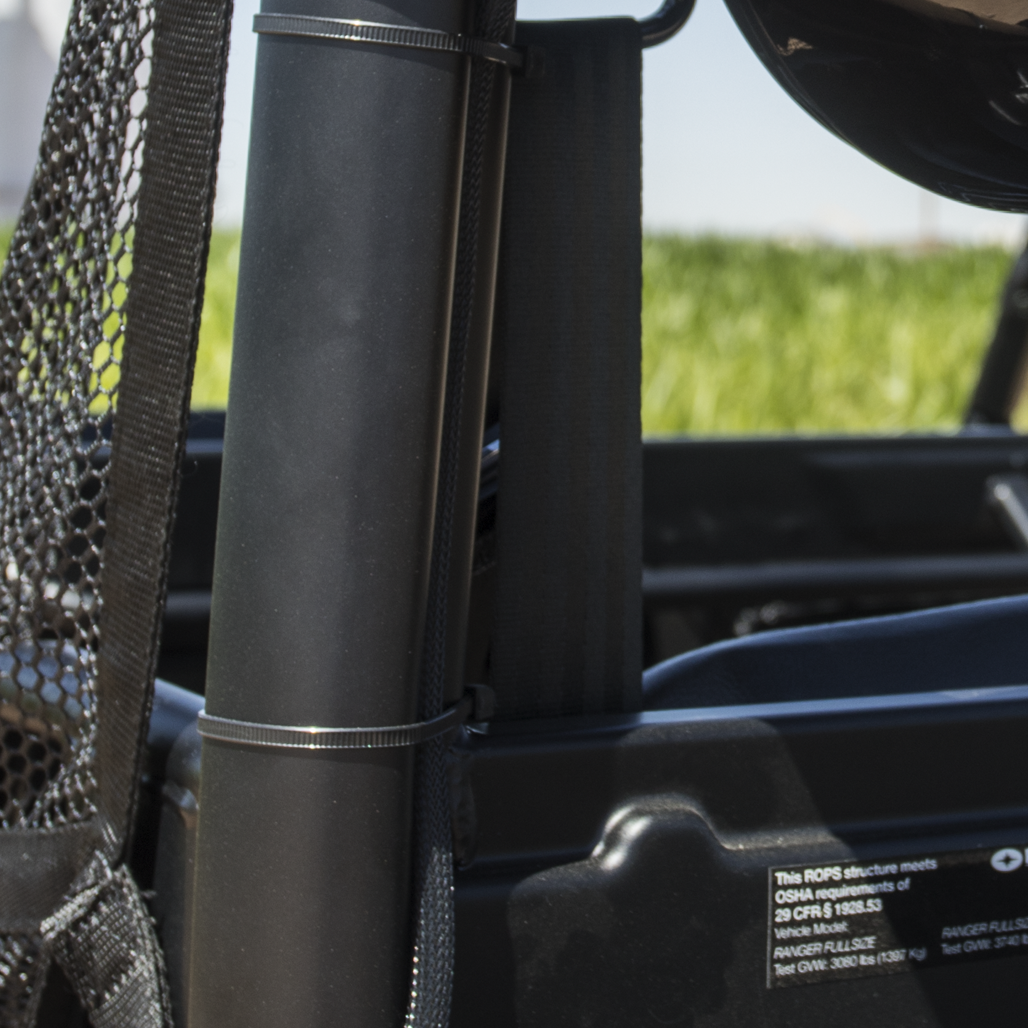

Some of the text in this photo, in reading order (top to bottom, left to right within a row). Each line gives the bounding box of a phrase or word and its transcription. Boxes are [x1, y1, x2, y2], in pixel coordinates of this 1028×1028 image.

[774, 858, 938, 886] This ROPS structure meets
[774, 877, 911, 904] OSHA requirements of
[774, 908, 792, 922] 29
[793, 905, 822, 920] CFR
[834, 898, 883, 916] 1928.53
[774, 925, 812, 940] Vehicle
[941, 923, 988, 939] RANGER
[773, 935, 878, 959] RANGER FULLSIZE
[940, 942, 963, 956] Test
[773, 962, 796, 976] Test
[858, 954, 876, 966] lbs
